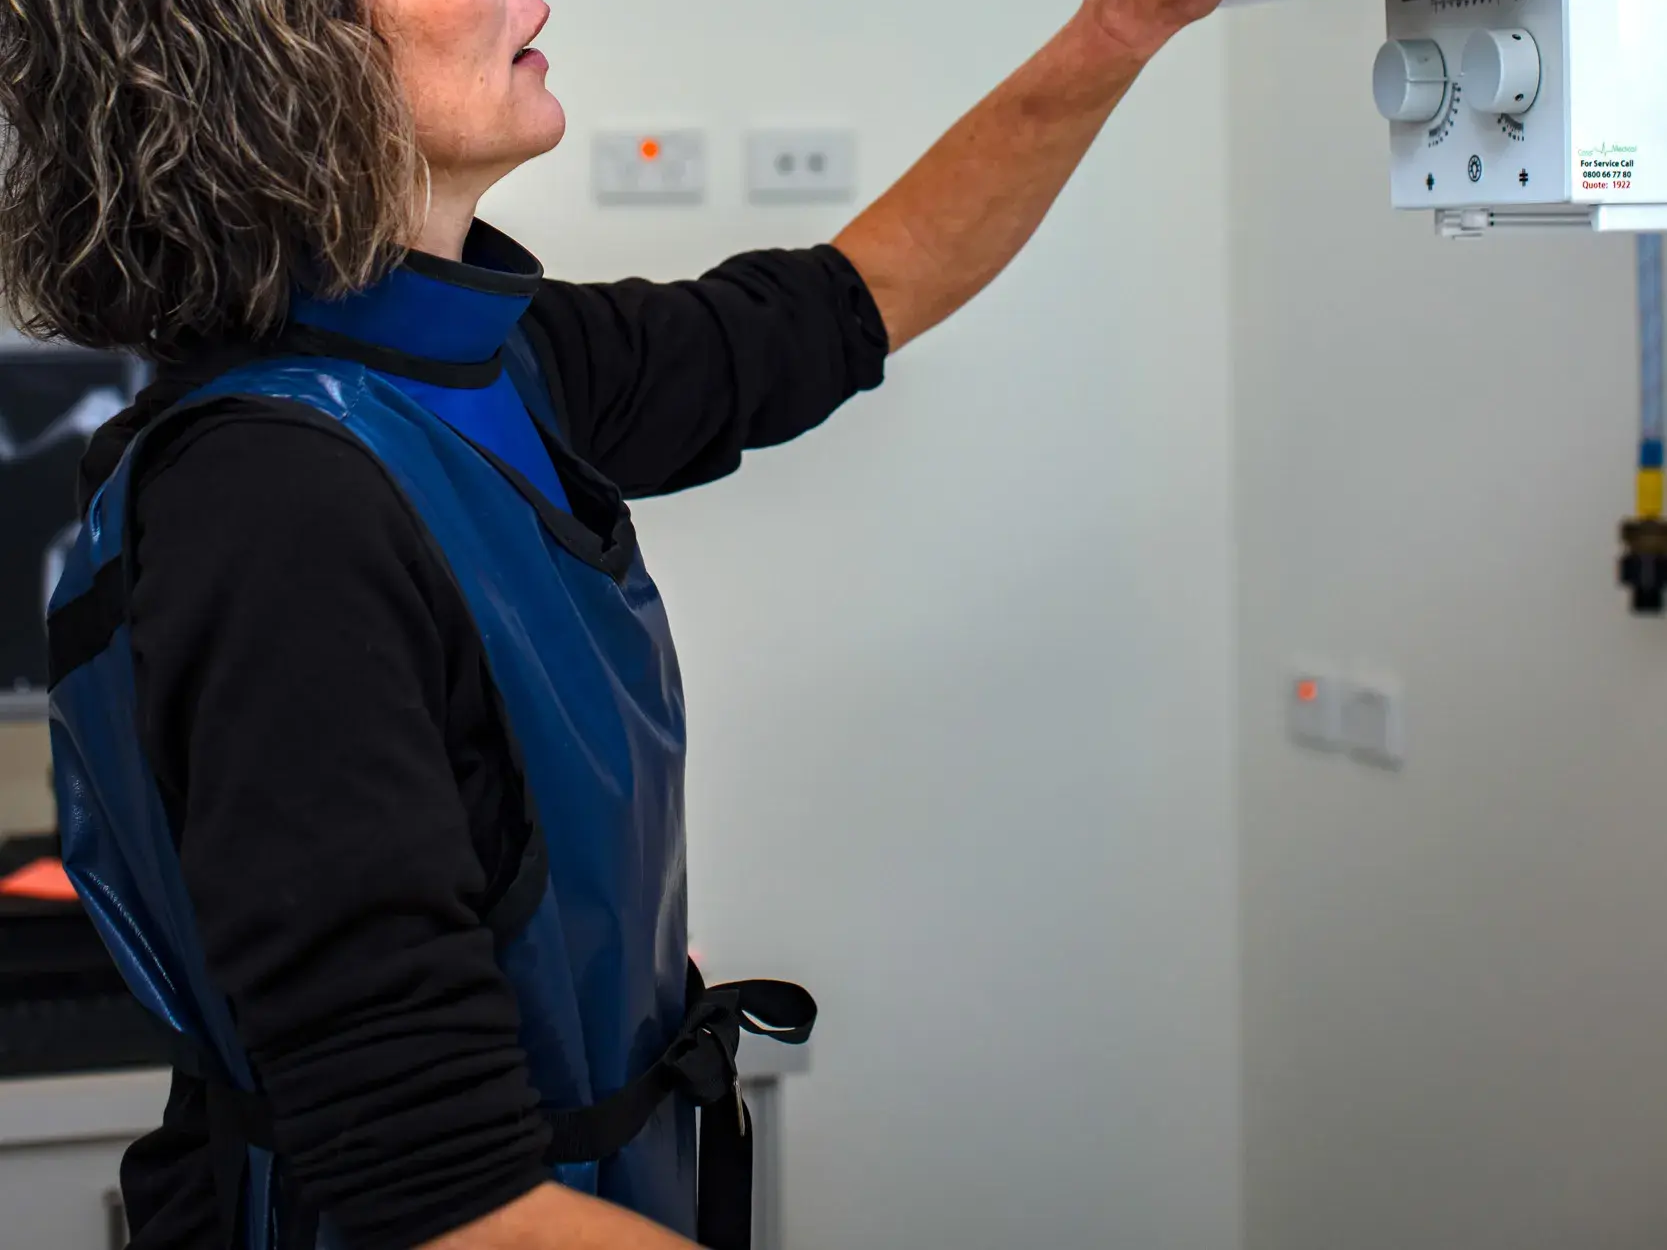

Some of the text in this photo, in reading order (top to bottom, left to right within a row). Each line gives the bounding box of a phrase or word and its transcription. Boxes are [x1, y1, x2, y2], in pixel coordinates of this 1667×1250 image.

[1580, 159, 1634, 167] For Service Call
[1582, 170, 1632, 178] 0800 66 77 80
[1582, 180, 1631, 189] Quote: 1922
